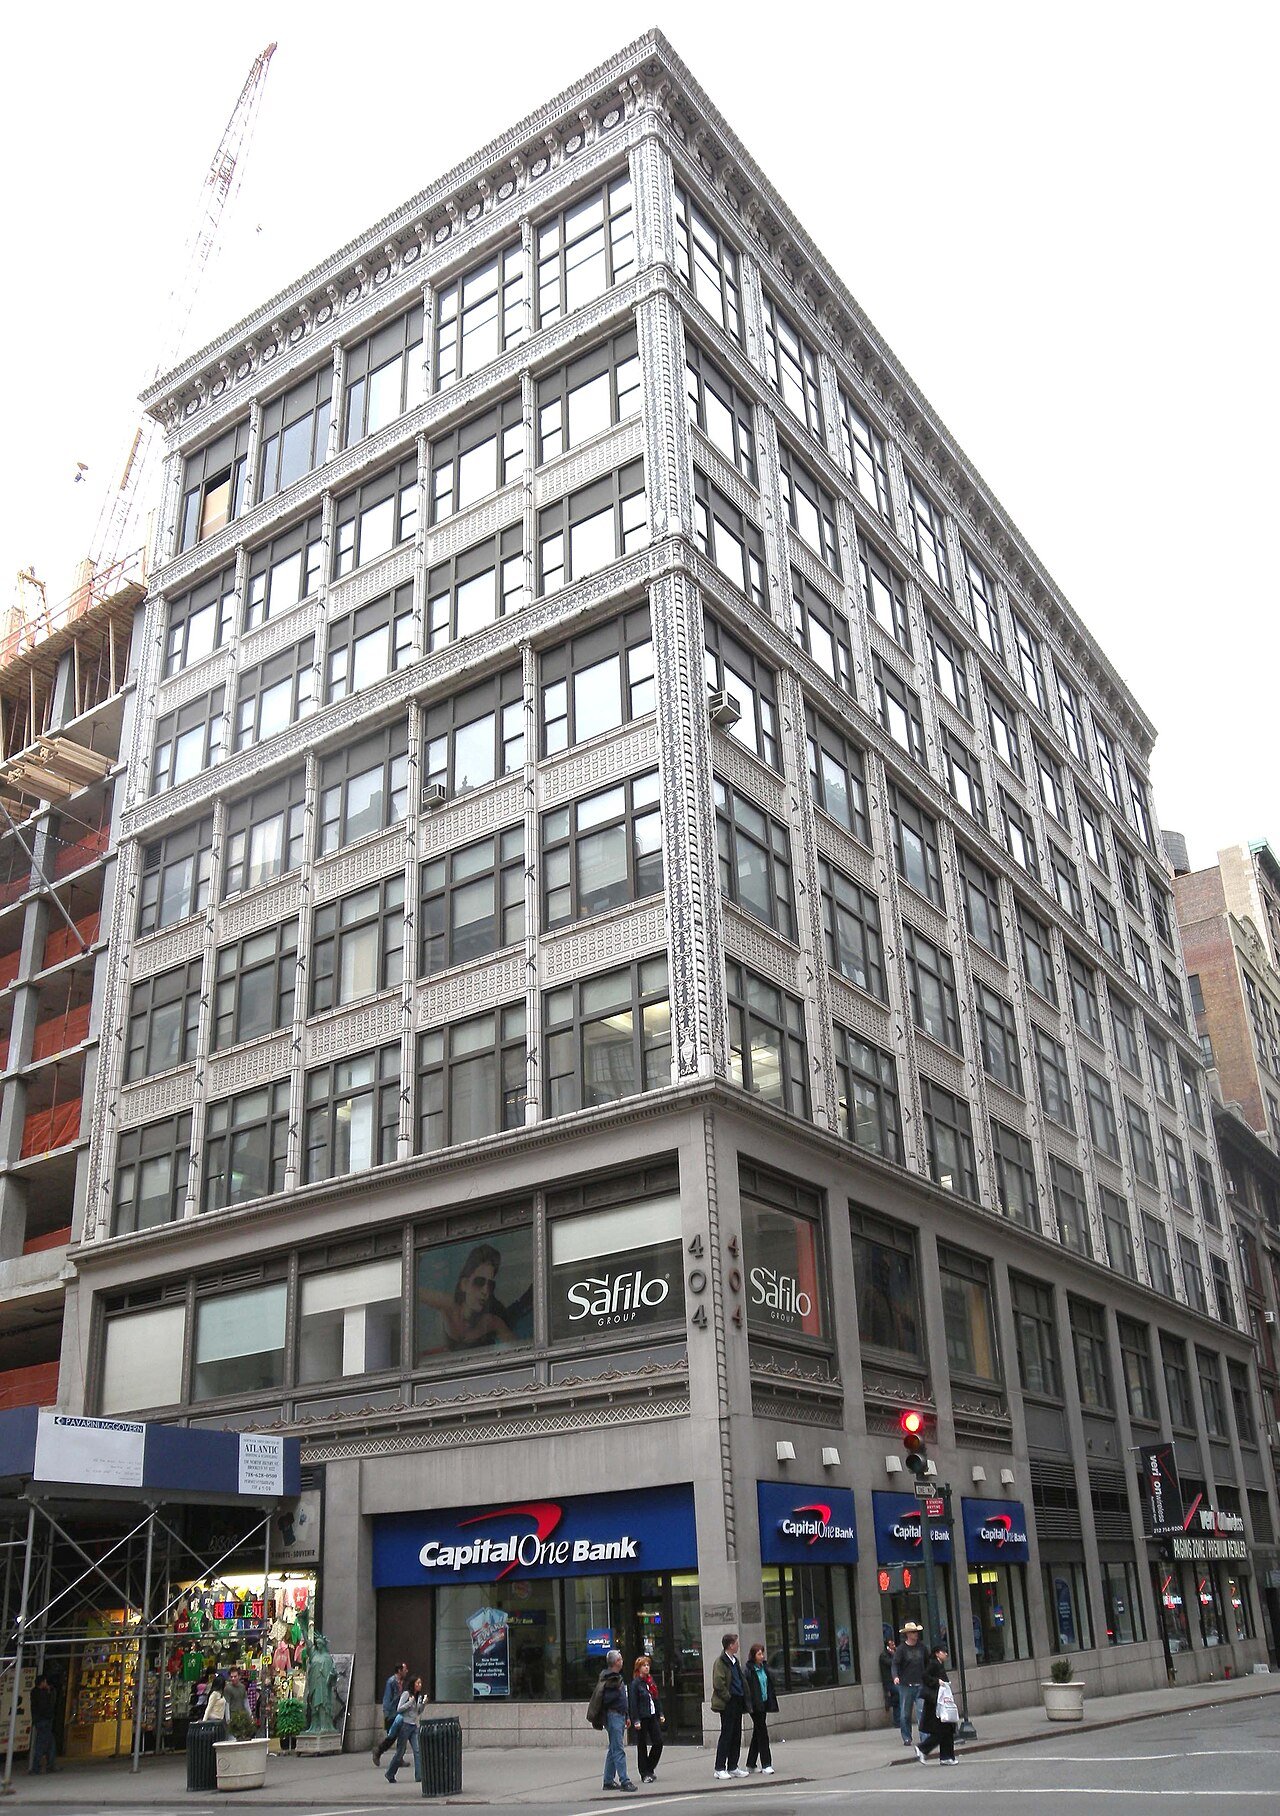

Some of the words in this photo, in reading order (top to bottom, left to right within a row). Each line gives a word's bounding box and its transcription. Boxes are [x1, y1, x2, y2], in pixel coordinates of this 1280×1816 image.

[598, 1312, 636, 1326] GROUP
[770, 1310, 794, 1324] GROUP
[66, 1418, 100, 1428] PAVARINI
[245, 1444, 278, 1454] ATLANTIC
[834, 1528, 854, 1540] Bank
[934, 1530, 950, 1541] Bank
[1014, 1534, 1027, 1542] Bank
[572, 1536, 638, 1562] Bank
